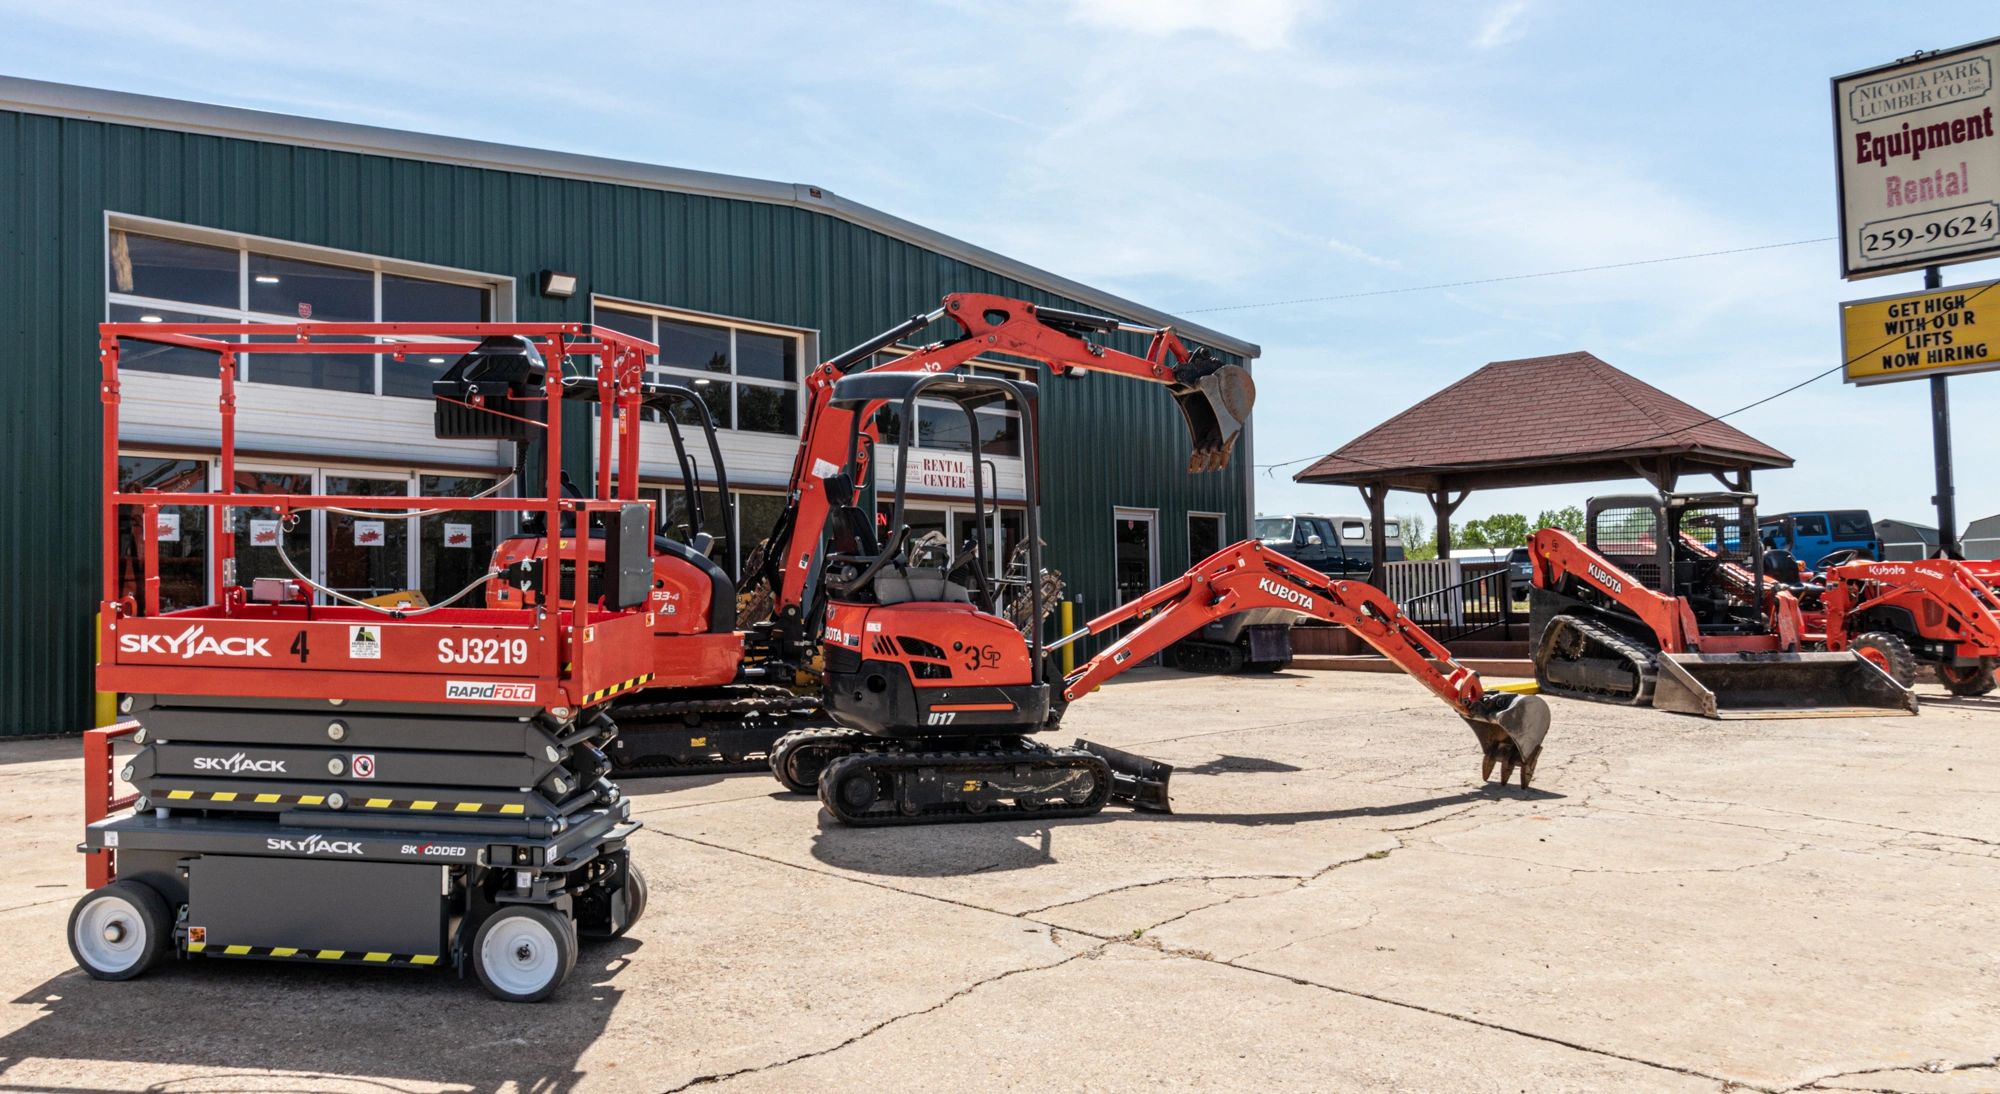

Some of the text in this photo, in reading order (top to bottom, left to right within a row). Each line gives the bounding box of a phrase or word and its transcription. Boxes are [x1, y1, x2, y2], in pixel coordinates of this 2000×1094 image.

[1860, 61, 1981, 102] NICOMA PARK
[1860, 84, 1967, 118] LUMBER CO.
[1855, 106, 1994, 168] Equipment
[1885, 161, 1969, 208] Rental
[1863, 210, 1994, 252] 259-9624
[1888, 295, 1966, 318] GET HIGH
[1884, 318, 1927, 336] WITH
[1905, 330, 1953, 350] LIFTS
[1882, 343, 1988, 369] NOW HIRING
[923, 458, 966, 474] RENTAL
[923, 474, 966, 489] CENTER
[875, 511, 888, 526] EN
[1587, 562, 1623, 594] KUBOTA
[1868, 564, 1906, 576] Kubota
[651, 591, 680, 601] 33-4
[1258, 577, 1313, 611] KUBOTA
[119, 624, 273, 660] SKYJACK
[824, 626, 843, 643] BOTA
[289, 630, 310, 664] 4
[437, 637, 528, 665] SJ3219
[964, 645, 981, 671] 3
[927, 712, 957, 726] U17
[193, 752, 288, 774] SKYJACK
[266, 834, 365, 855] SKYJACK
